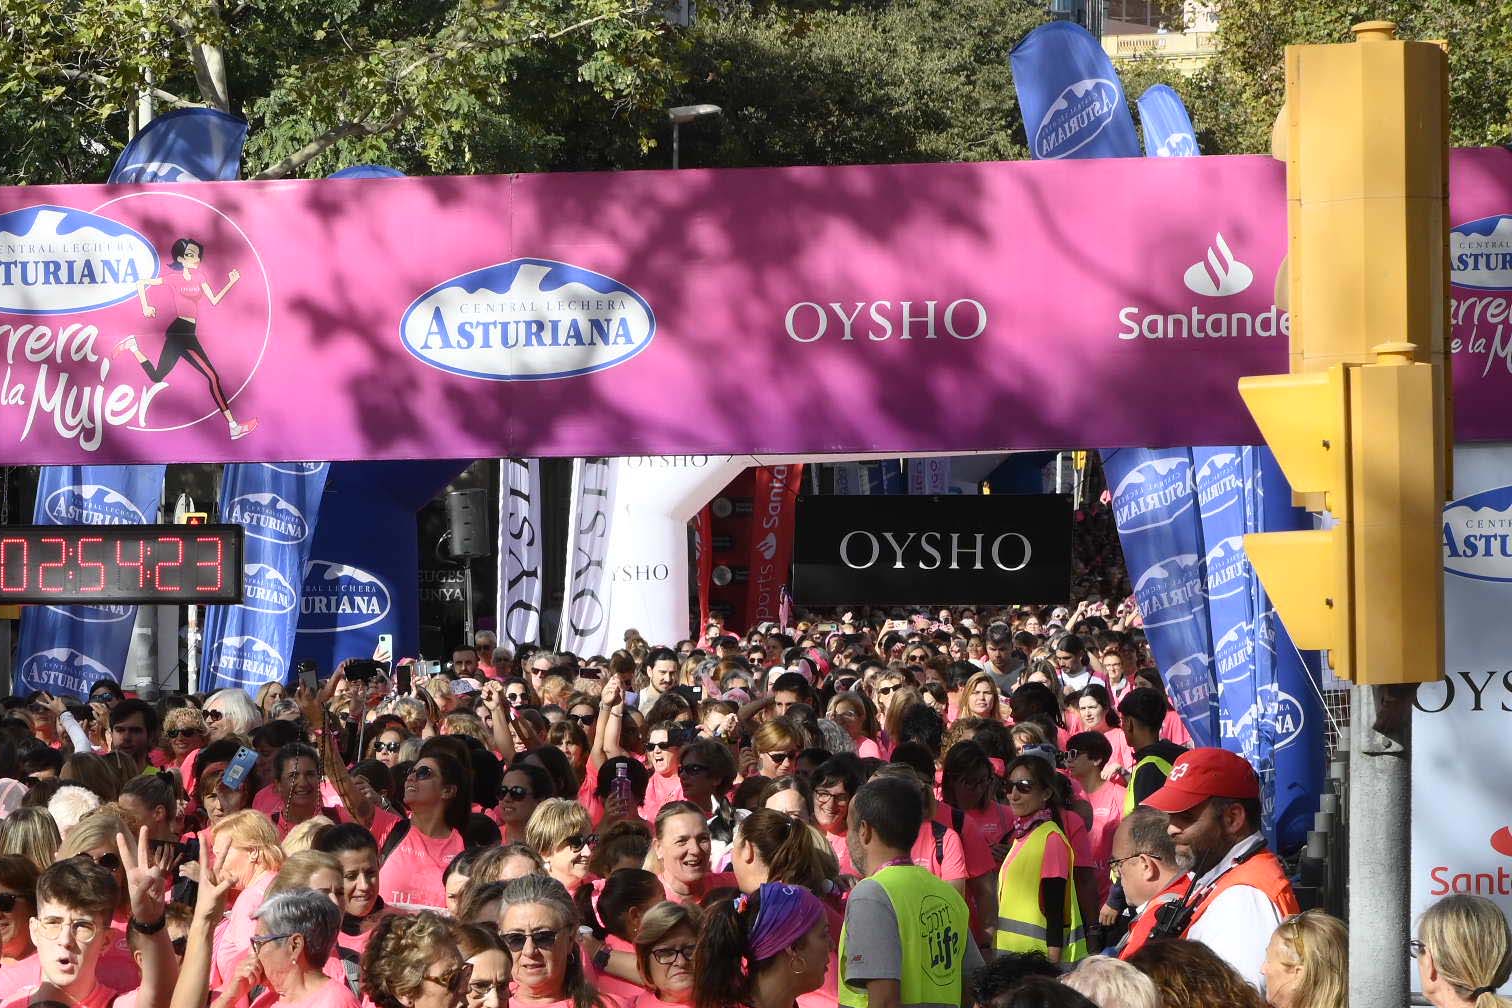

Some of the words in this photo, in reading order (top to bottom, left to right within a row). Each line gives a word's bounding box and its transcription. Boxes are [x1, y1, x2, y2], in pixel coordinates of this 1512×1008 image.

[420, 305, 636, 350] ASTURIANA
[460, 302, 537, 315] CENTRAL
[546, 299, 626, 312] LECHERA
[785, 298, 987, 343] OYSHO
[1468, 329, 1485, 354] la
[0, 367, 25, 406] la
[20, 358, 169, 451] Mujer
[626, 456, 709, 468] OYSHO
[0, 537, 223, 592] 02:54:23
[840, 530, 1032, 571] OYSHO
[929, 926, 960, 970] Life
